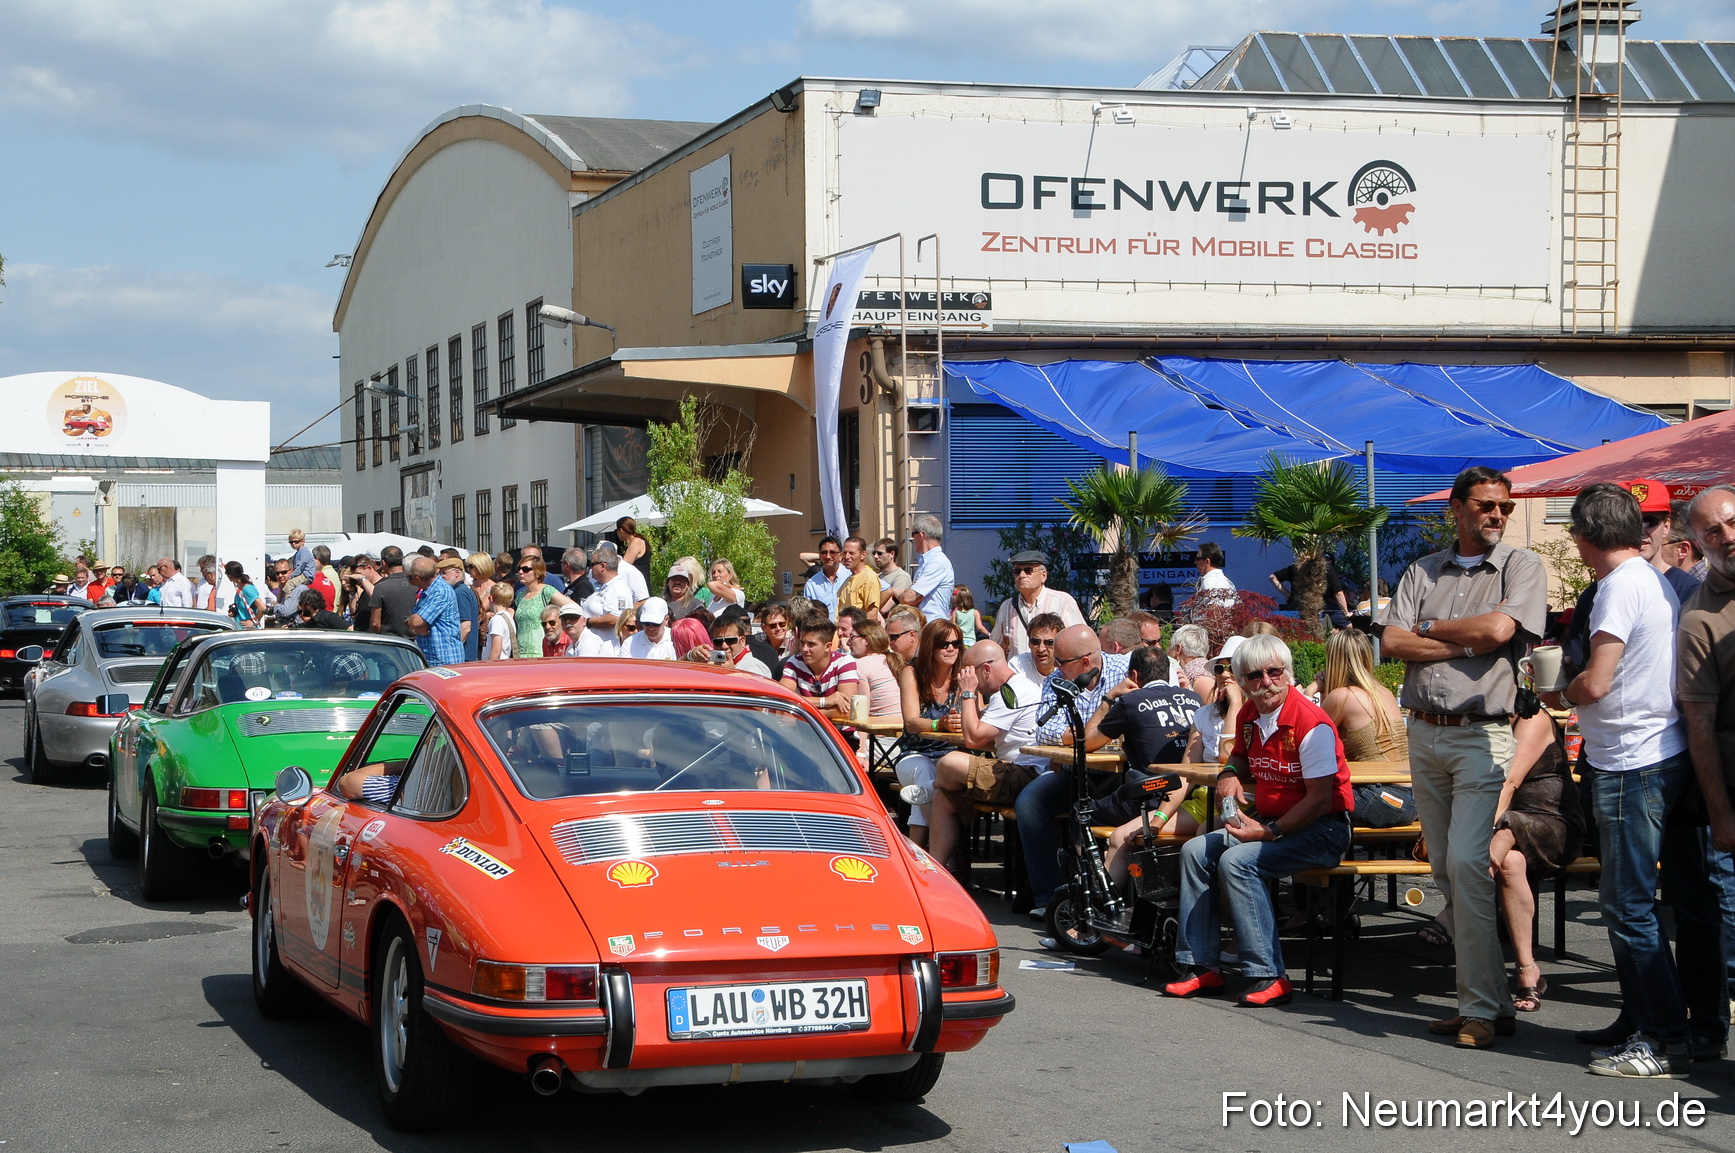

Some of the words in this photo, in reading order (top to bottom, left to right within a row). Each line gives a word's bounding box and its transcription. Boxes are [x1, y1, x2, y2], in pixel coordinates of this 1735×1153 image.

[980, 172, 1341, 217] OFENWERK
[750, 274, 789, 299] sky
[861, 291, 970, 302] FENWERK
[853, 311, 982, 322] HAUPEINGANG
[859, 351, 873, 405] 3
[74, 380, 100, 393] ZIEL
[1248, 757, 1302, 773] ORSCHE
[455, 846, 509, 875] DUNLOP
[643, 923, 891, 940] PORSCHE
[613, 937, 630, 946] TAG
[758, 937, 788, 950] HEUER
[690, 991, 748, 1026] LAU
[770, 988, 807, 1021] WB
[812, 986, 866, 1019] 32H
[675, 1015, 684, 1026] D
[731, 1028, 764, 1036] Autoservice
